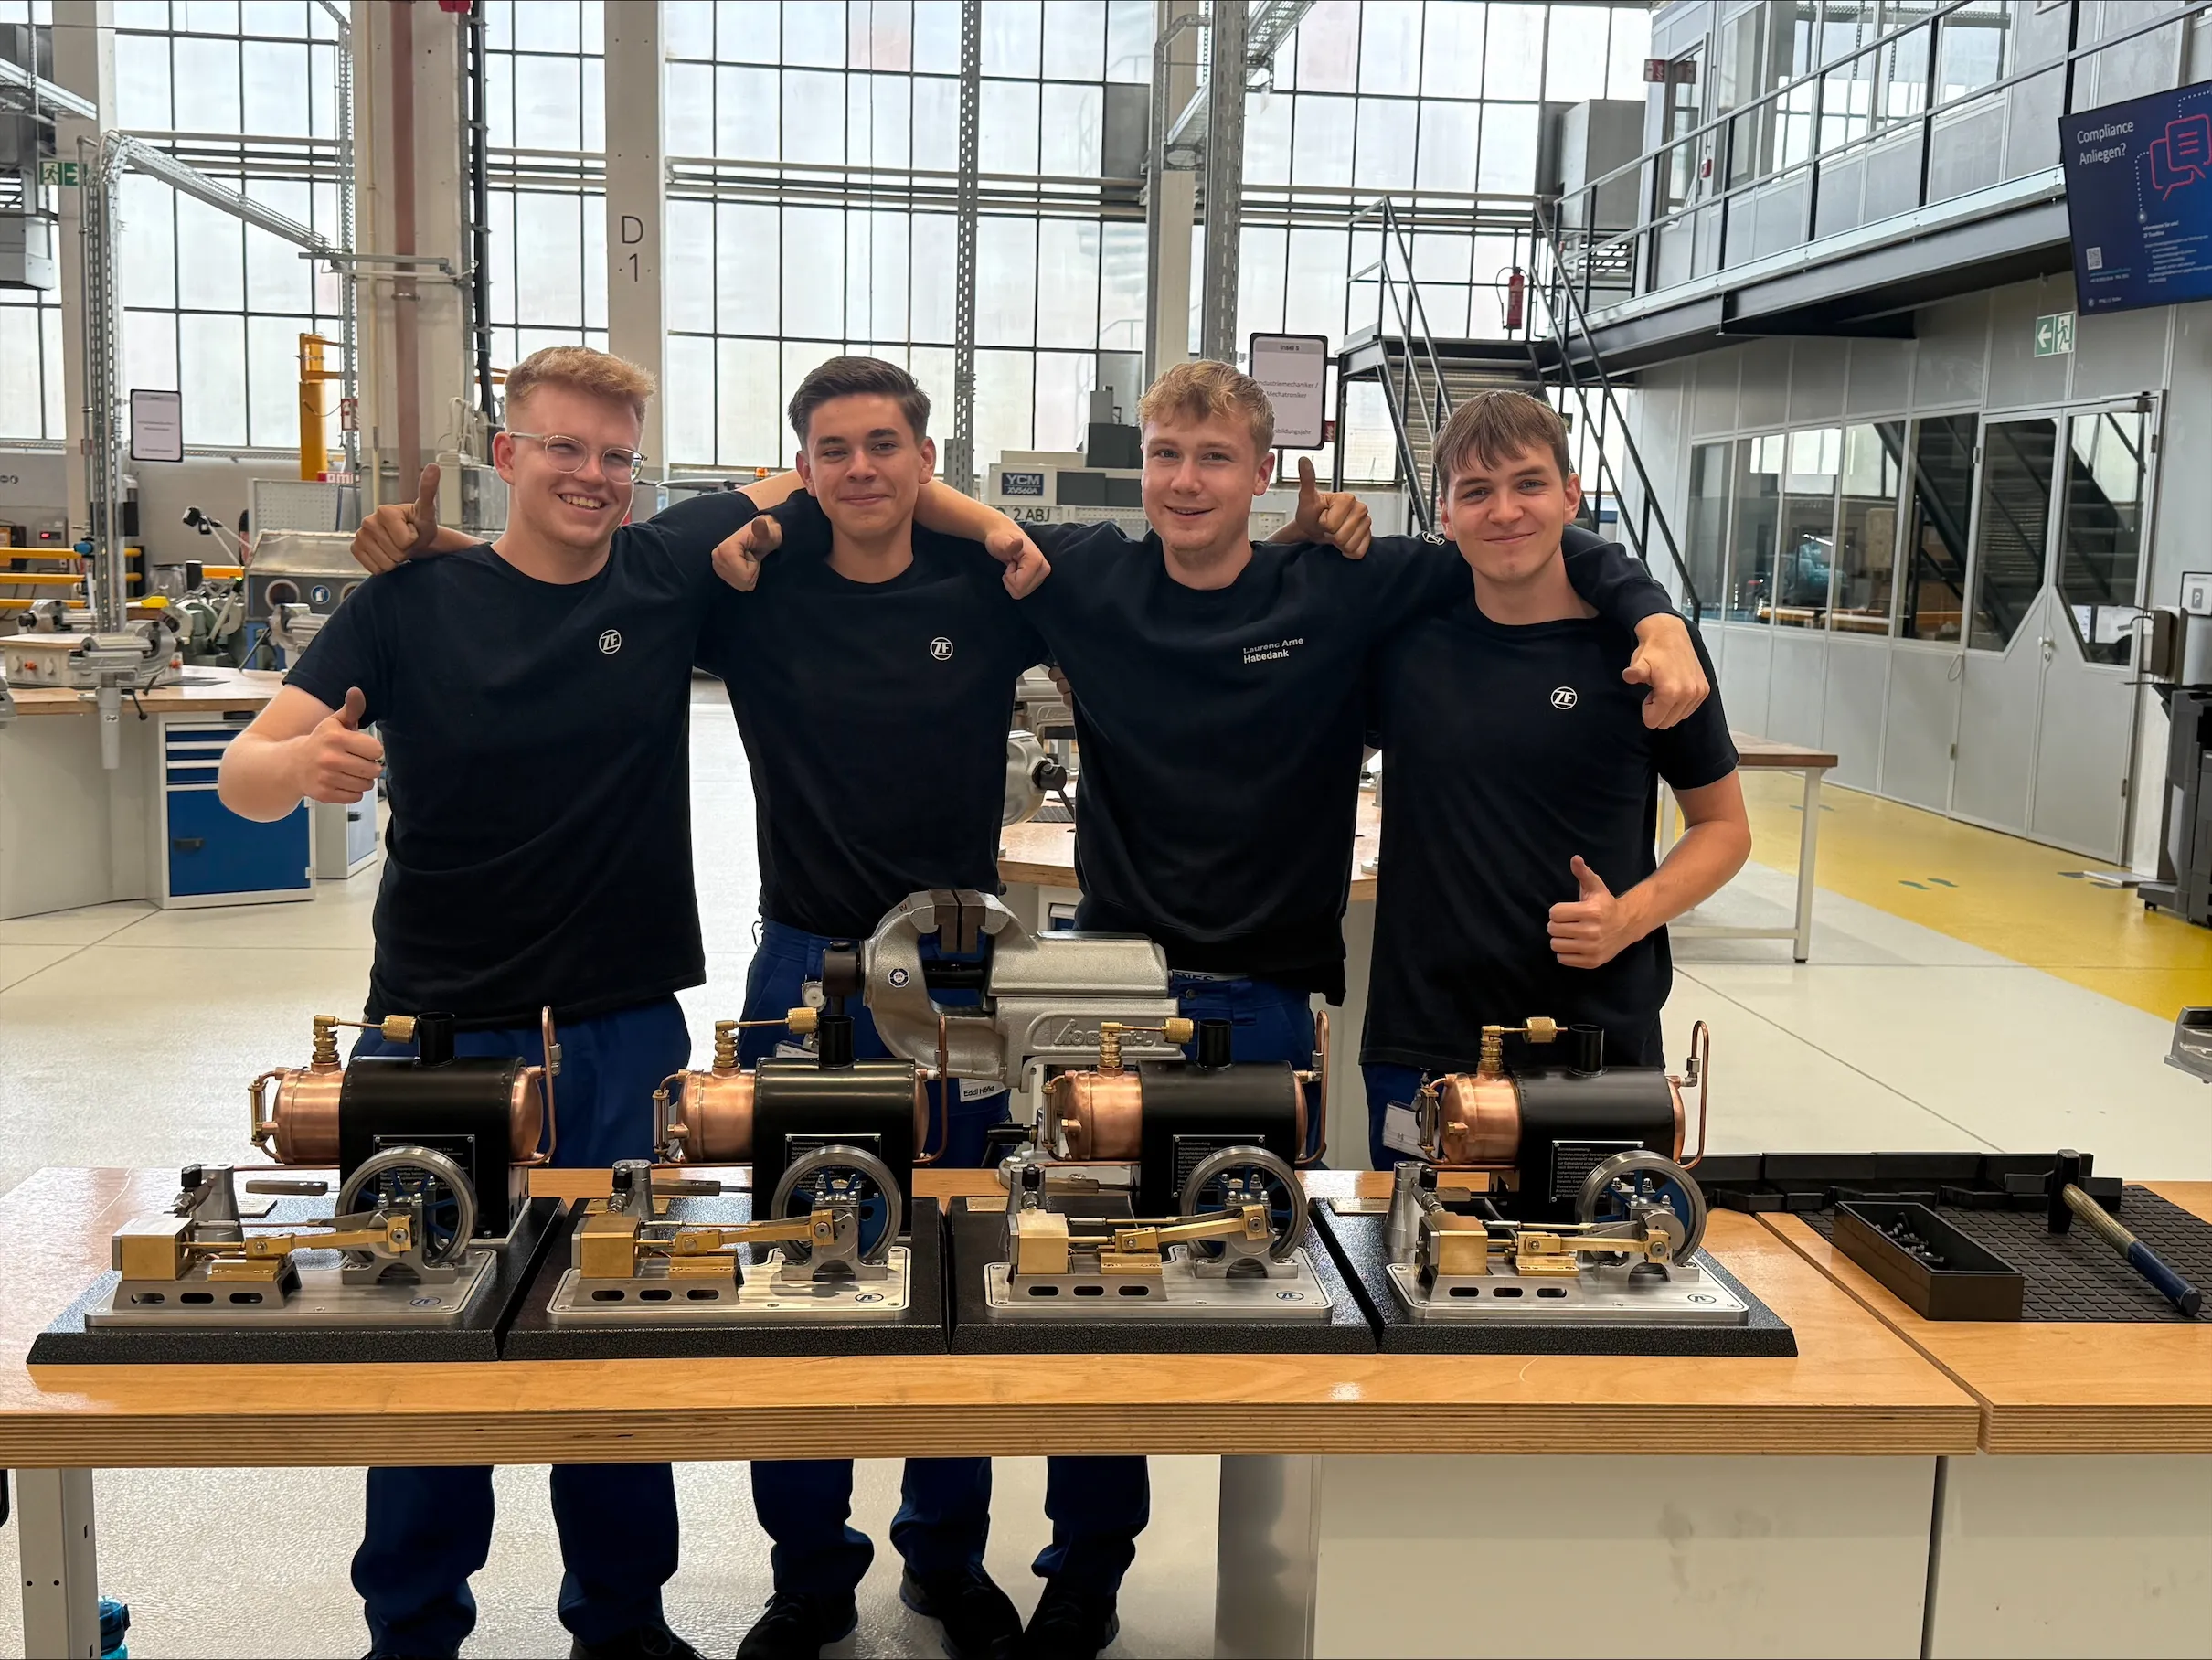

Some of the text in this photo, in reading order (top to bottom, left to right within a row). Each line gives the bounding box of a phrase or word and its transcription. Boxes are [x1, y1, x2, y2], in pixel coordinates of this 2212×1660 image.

[2077, 122, 2134, 144] Compliance
[2079, 142, 2127, 165] Anliegen?
[622, 215, 643, 244] D
[629, 253, 638, 282] 1
[1006, 474, 1040, 484] YCM
[600, 632, 621, 651] ZF
[931, 641, 952, 655] ZF
[1281, 638, 1304, 647] Arne
[1243, 648, 1290, 664] Habedank
[1553, 690, 1576, 706] ZF
